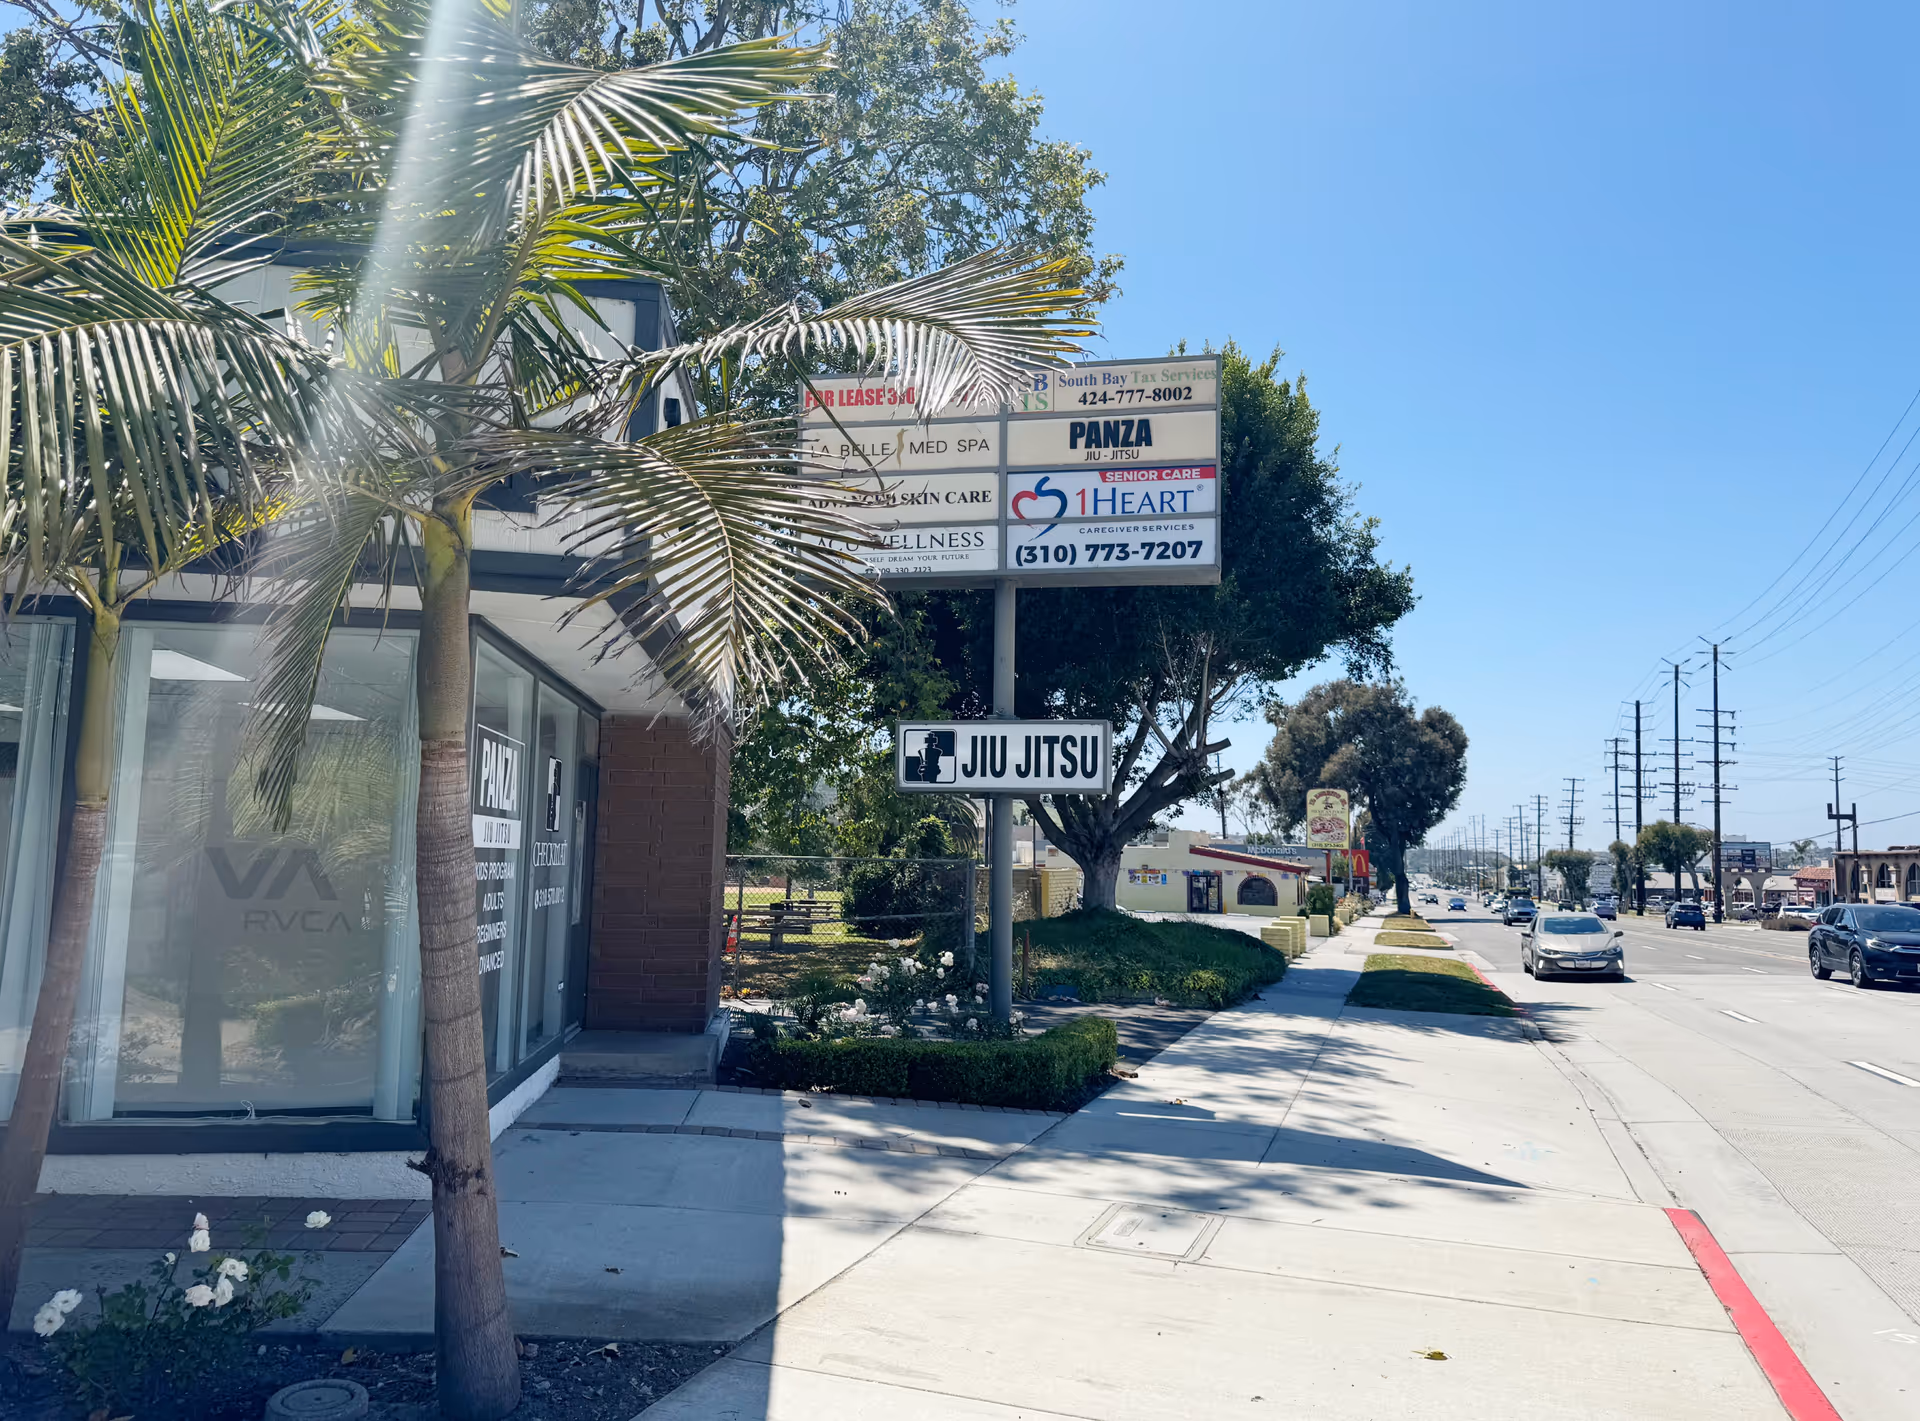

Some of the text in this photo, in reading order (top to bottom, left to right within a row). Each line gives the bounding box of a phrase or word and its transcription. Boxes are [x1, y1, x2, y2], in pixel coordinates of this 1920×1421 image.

[1059, 367, 1217, 388] South Bay Tax Services
[805, 390, 834, 407] FOR
[839, 388, 885, 406] LEASE
[1078, 386, 1193, 406] 424-777-8002
[1069, 418, 1152, 449] PANZA
[811, 438, 990, 458] LA BELLE MED SPA
[1105, 468, 1201, 482] SENIOR CARE
[900, 491, 940, 506] SKIN
[945, 490, 992, 504] CARE
[1079, 523, 1195, 534] CAREGIVER SERVICES
[941, 553, 970, 561] FUTURE
[1015, 540, 1203, 567] (310) 773-7207
[961, 734, 1099, 779] JIU JITSU
[480, 737, 518, 812] PANZA
[483, 821, 511, 844] JIU JITSU
[1247, 845, 1297, 855] McDonald's
[475, 861, 515, 881] KIDS PROGRAM
[482, 891, 505, 912] ADULTS
[243, 909, 352, 934] RVCA
[478, 950, 505, 975] DVANCED
